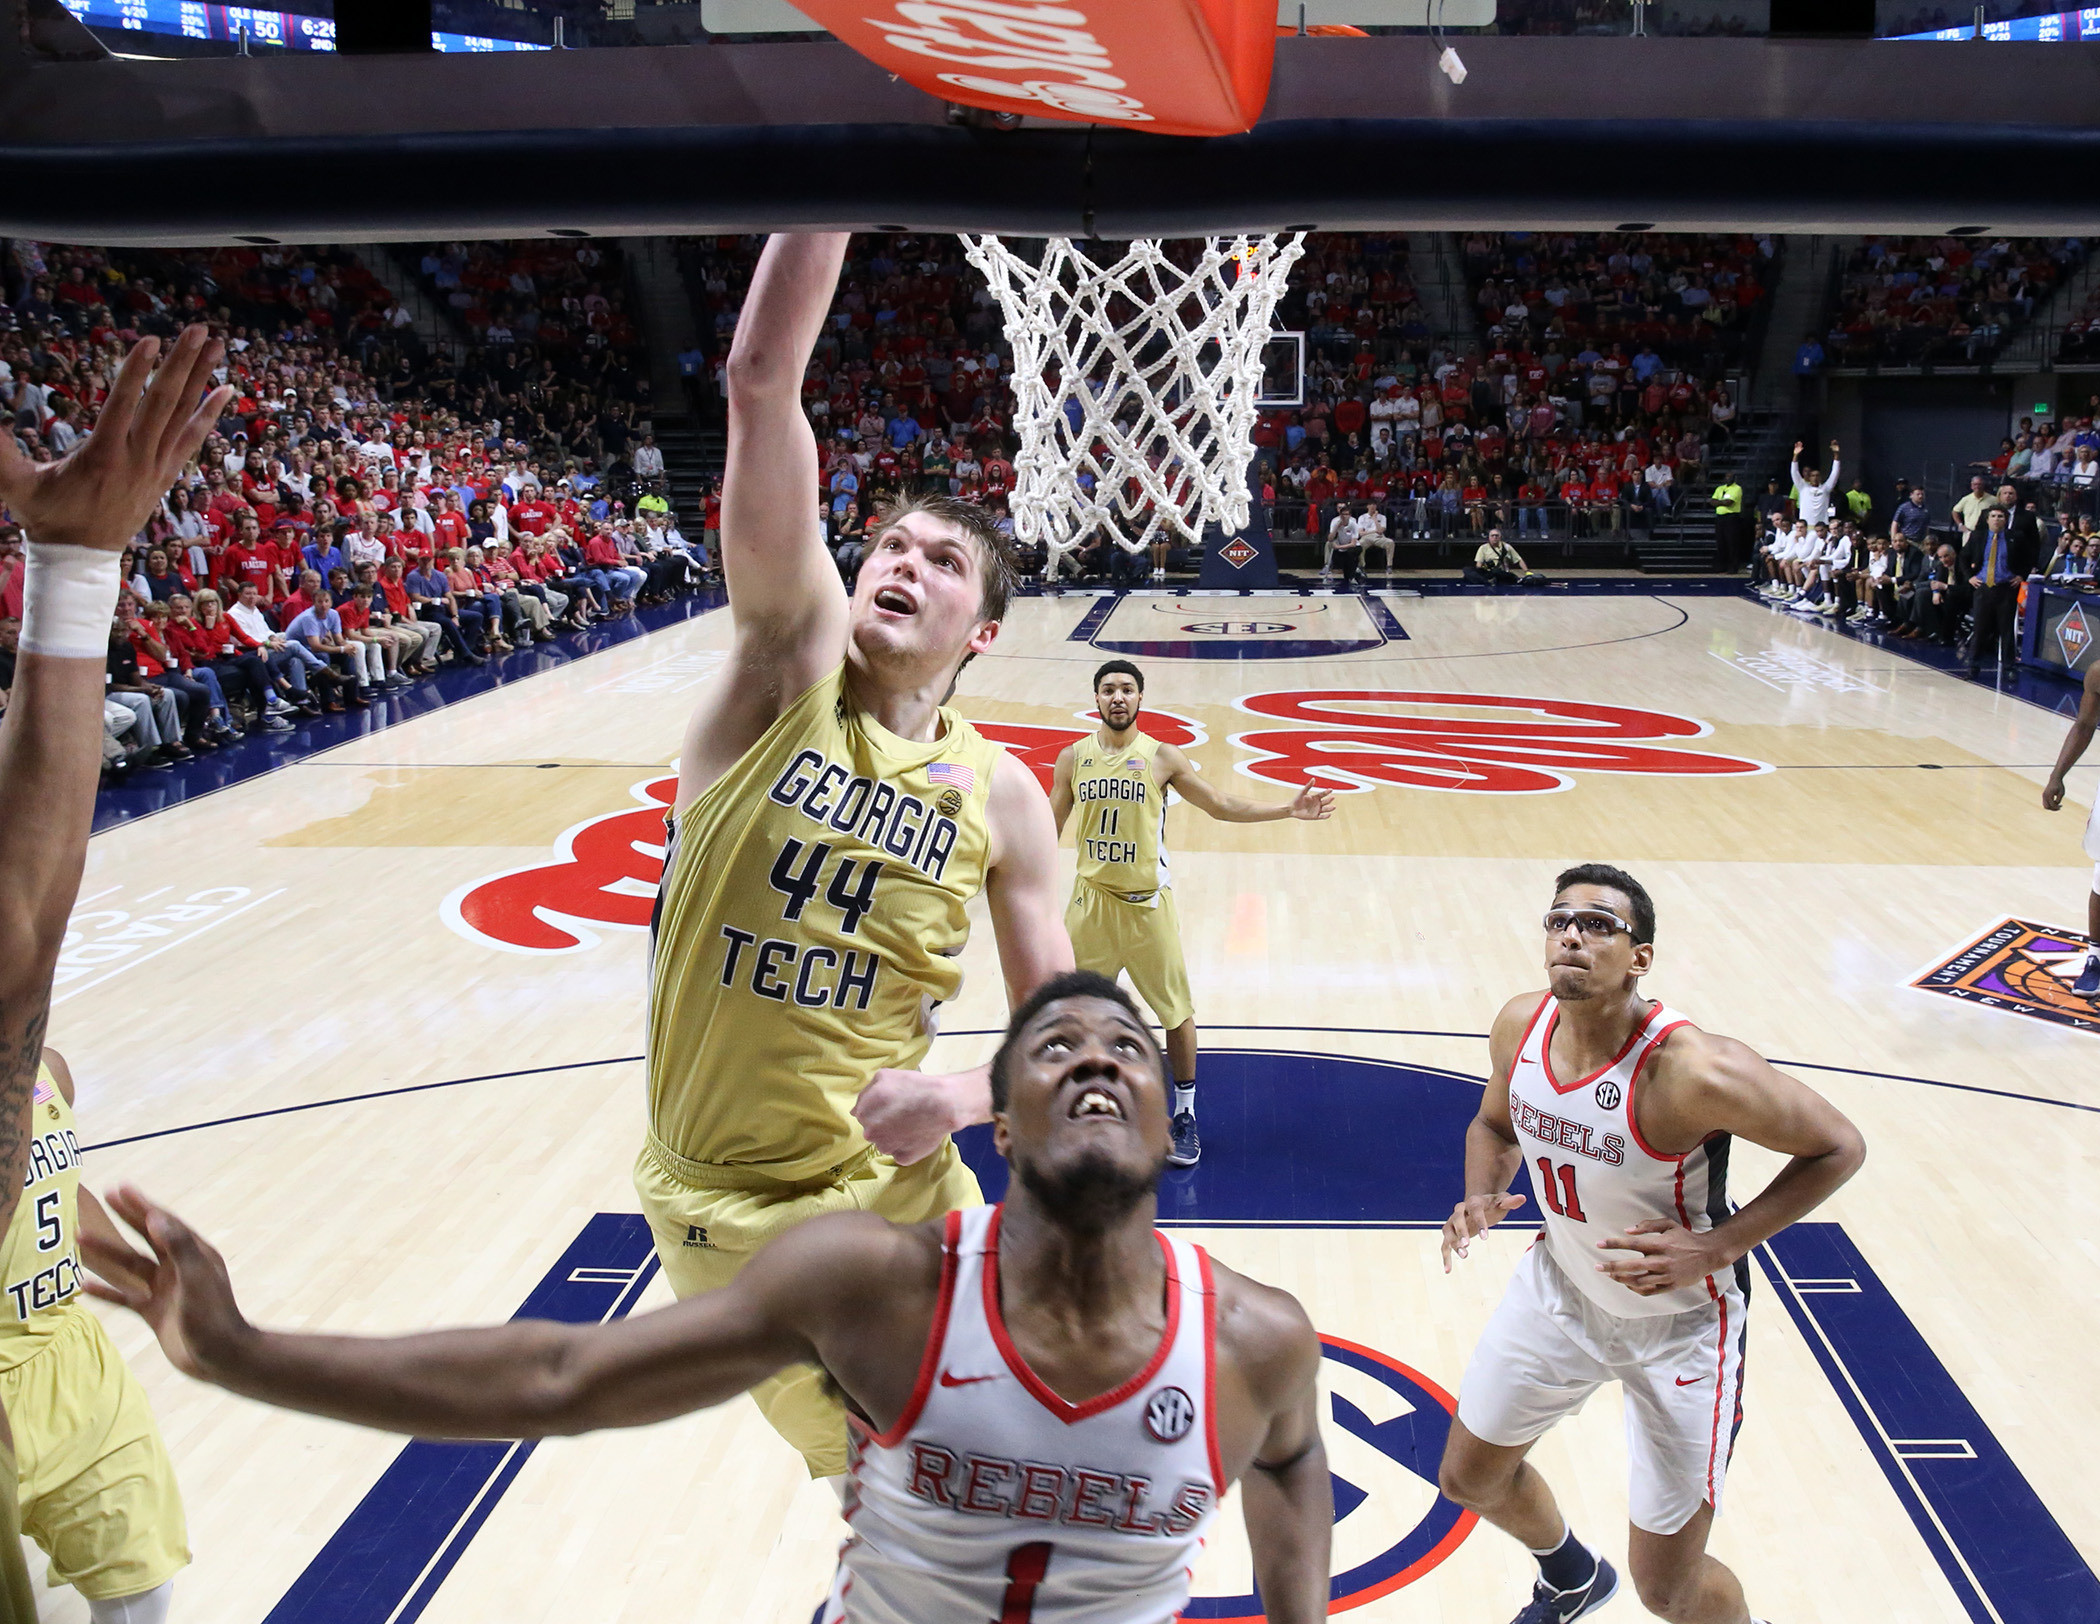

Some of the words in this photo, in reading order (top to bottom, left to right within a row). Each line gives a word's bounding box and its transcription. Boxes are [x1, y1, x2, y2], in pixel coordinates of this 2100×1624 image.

[121, 6, 148, 19] 4/20
[229, 6, 251, 20] OLE
[252, 9, 280, 23] MISS
[255, 20, 279, 39] 50
[1983, 21, 2011, 34] 20/51
[2064, 627, 2085, 643] NIT
[1230, 689, 1774, 795] Ole
[768, 747, 960, 885] GEORGIA
[1078, 777, 1146, 804] GEORGIA
[1100, 807, 1120, 836] 11
[1086, 838, 1137, 864] TECH
[769, 835, 886, 936] 44
[53, 886, 251, 985] CRADD
[1932, 927, 2021, 984] TOURNAMENT
[720, 923, 881, 1011] TECH
[1596, 1082, 1621, 1109] SEC
[1510, 1089, 1625, 1167] REBELS
[1536, 1156, 1588, 1224] 11
[34, 1188, 63, 1255] 5
[682, 1240, 718, 1250] RUSSELL
[1147, 1387, 1195, 1440] SEC
[907, 1439, 1216, 1537] REBELS
[988, 1540, 1055, 1624] 1
